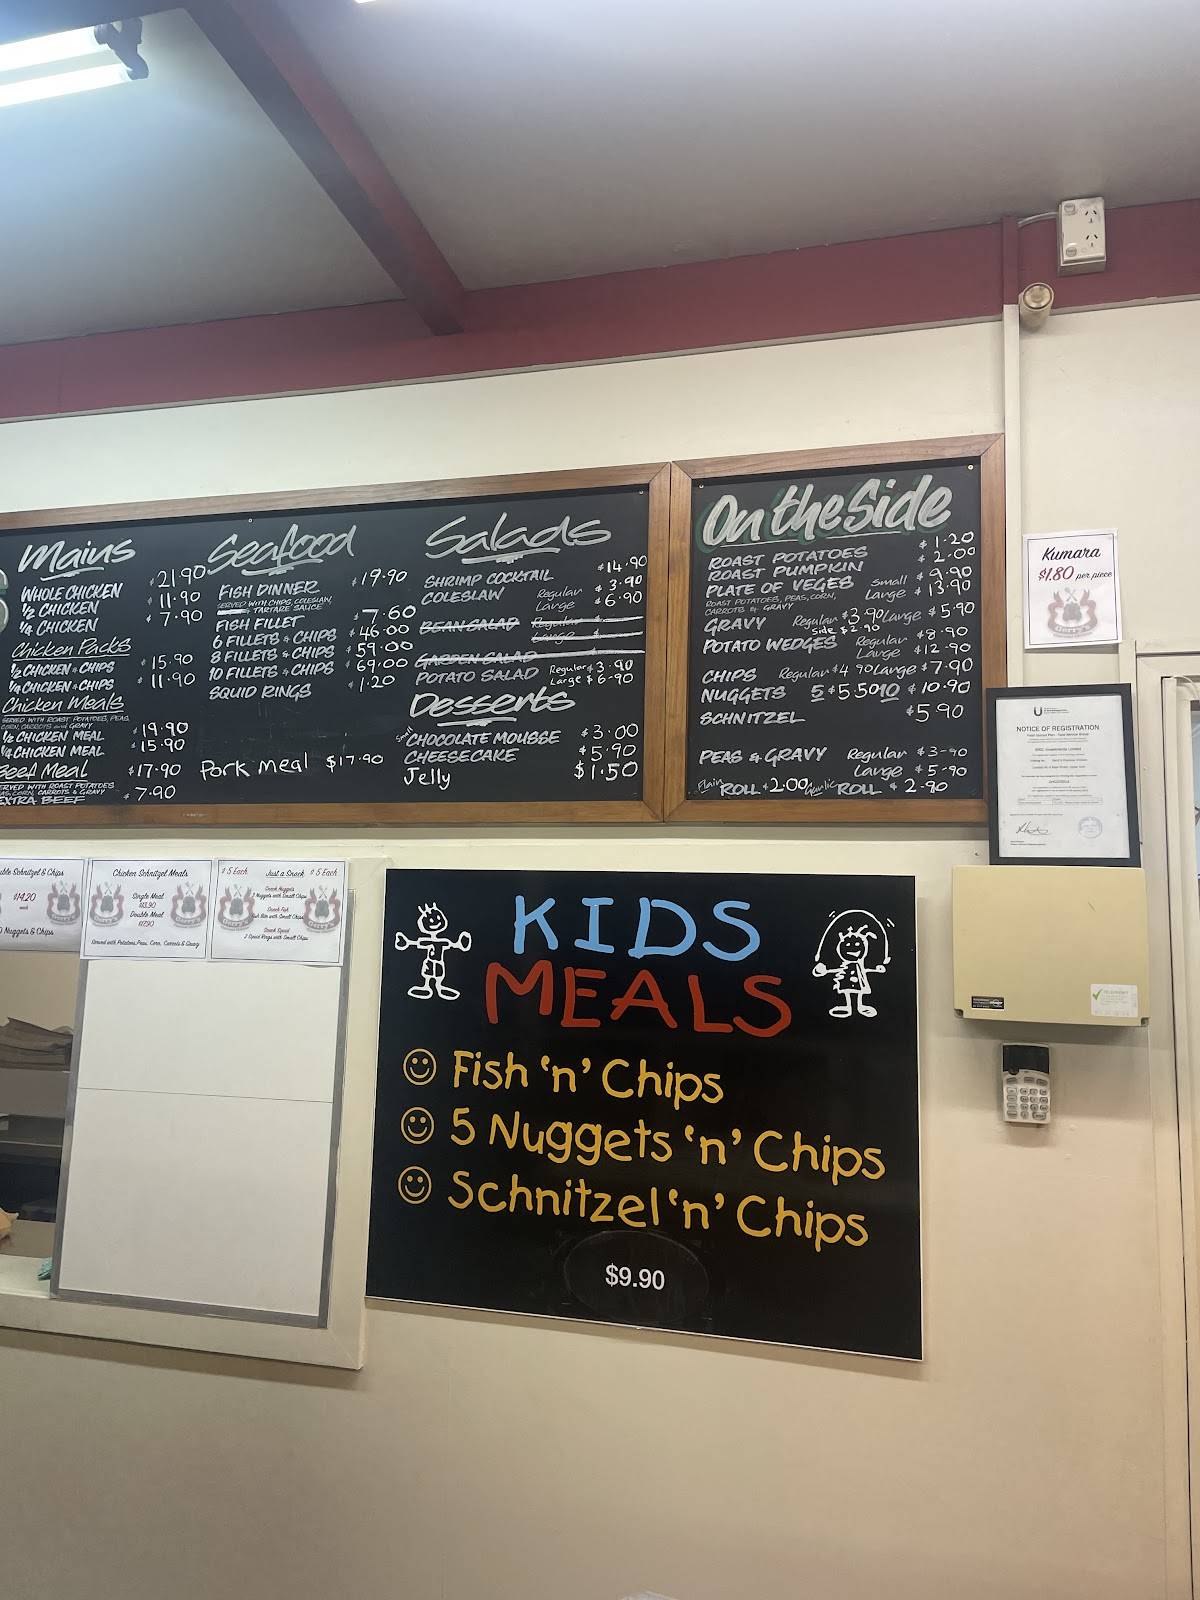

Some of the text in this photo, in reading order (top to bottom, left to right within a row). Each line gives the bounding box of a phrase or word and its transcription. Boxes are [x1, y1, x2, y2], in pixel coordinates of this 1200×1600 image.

[703, 475, 952, 546] On the Side
[425, 512, 612, 559] Salads
[18, 539, 136, 572] Mains
[207, 524, 357, 575] Seafood
[708, 555, 765, 571] ROAST
[772, 546, 868, 563] POTATOES
[1042, 547, 1101, 561] Kumara
[424, 574, 483, 588] SHRIMP
[486, 569, 553, 585] COCKTAIL
[708, 568, 765, 582] ROAST
[773, 561, 864, 578] PUMPKIN
[1038, 566, 1112, 582] $1.80 per piece
[21, 586, 62, 602] WHOLE
[64, 583, 123, 599] CHICKEN
[219, 585, 253, 600] FISH
[257, 581, 320, 596] DINNER
[421, 587, 505, 605] COLESLAW
[537, 586, 583, 600] Regular
[705, 584, 755, 598] PLATE
[761, 582, 782, 594] OF
[793, 577, 854, 591] VEGES
[865, 589, 906, 602] Large
[38, 601, 99, 617] CHICKEN
[536, 601, 576, 612] Large
[763, 603, 794, 611] GRAVY
[36, 618, 98, 636] CHICKEN
[216, 619, 249, 632] FISH
[254, 616, 305, 630] FILLET
[704, 617, 767, 636] GRAVY
[793, 614, 839, 629] Regular
[882, 610, 922, 625] Large
[12, 637, 131, 658] Chicken Packs
[213, 636, 222, 649] 6
[226, 632, 279, 647] FILLETS
[293, 629, 337, 644] CHIPS
[703, 639, 761, 654] POTATO
[766, 637, 838, 653] WEDGES
[856, 635, 908, 649] Regular
[211, 646, 335, 663] 8 FILLETS CHIPS
[856, 648, 901, 661] Large
[23, 663, 69, 678] CHICKEN
[79, 662, 115, 674] CHIPS
[209, 662, 334, 681] 10 FILLETS CHIPS
[415, 664, 586, 685] POTATO SALAD Regular
[702, 669, 757, 684] CHIPS
[779, 667, 829, 680] Regular
[873, 663, 917, 679] Large
[21, 681, 70, 694] CHICKEN
[79, 679, 114, 691] CHIPS
[550, 676, 581, 687] Large
[209, 687, 257, 700] SQUID
[262, 684, 312, 702] RINGS
[409, 686, 576, 718] Desserts
[701, 686, 787, 705] NUGGETS
[2, 693, 124, 713] Chicken Meals
[700, 712, 805, 726] SCHNITZEL
[16, 731, 67, 742] CHICKEN
[73, 730, 105, 741] MEAL
[406, 733, 489, 747] CHOCOLATE
[493, 730, 561, 745] MOUSSE
[13, 746, 66, 759] CHICKEN
[70, 746, 105, 757] MEAL
[404, 748, 519, 764] CHEESECAKE
[699, 747, 907, 766] PEAS & GRAVY Regular
[41, 760, 88, 779] Meal
[200, 752, 384, 781] Pork meal $17.90
[854, 765, 903, 780] Large
[404, 768, 450, 790] Jelly
[720, 783, 882, 796] ROLL ROLL
[41, 796, 85, 804] BEEF
[47, 868, 64, 877] Chips
[113, 869, 188, 880] Chicken Schnitzel Meals
[37, 928, 54, 936] Chips
[513, 894, 761, 962] KIDS
[485, 959, 791, 1038] MEALS
[453, 1051, 529, 1089] Fish
[602, 1059, 724, 1110] Chips
[450, 1107, 476, 1146] 5
[489, 1111, 672, 1166] Nuggets
[753, 1130, 885, 1186] Chips
[448, 1170, 658, 1228] Schnitzel
[737, 1195, 869, 1252] Chips
[606, 1264, 666, 1290] $9.90
